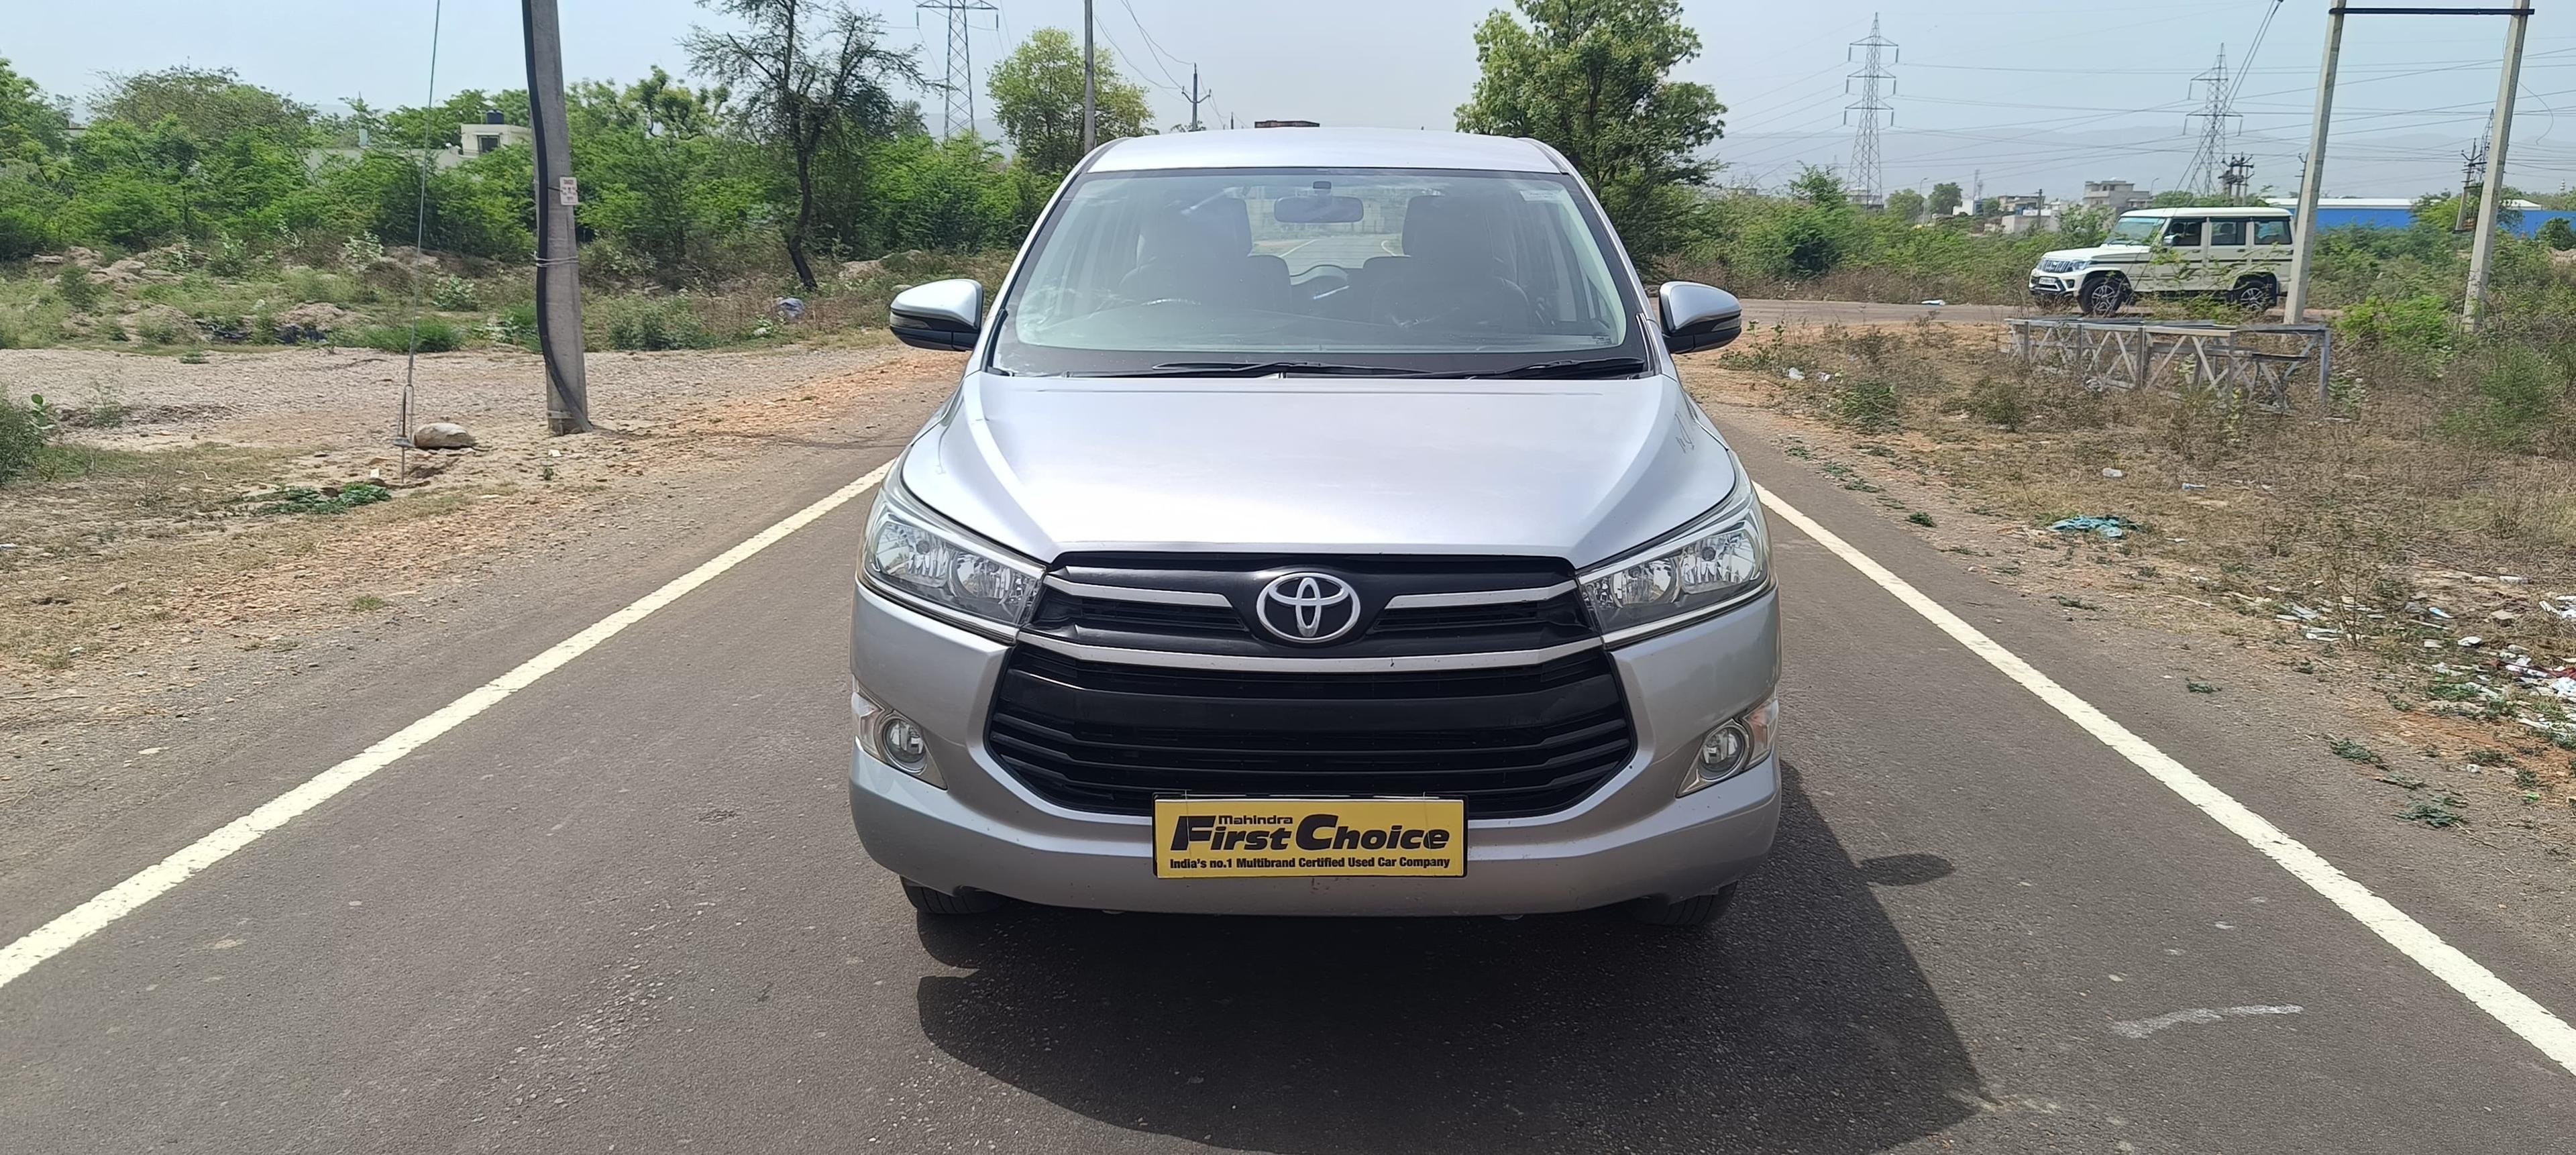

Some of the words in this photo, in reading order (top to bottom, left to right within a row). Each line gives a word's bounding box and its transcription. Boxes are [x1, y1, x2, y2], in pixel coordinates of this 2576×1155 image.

[1218, 815, 1293, 824] Mahindra
[1170, 816, 1292, 850] First
[1295, 814, 1450, 850] Choice
[1170, 859, 1207, 869] India's
[1210, 859, 1232, 869] no.1
[1236, 858, 1295, 868] Multibrand
[1299, 858, 1344, 867] Certified
[1348, 857, 1375, 867] Used
[1378, 857, 1397, 867] Car
[1399, 857, 1450, 868] Company
